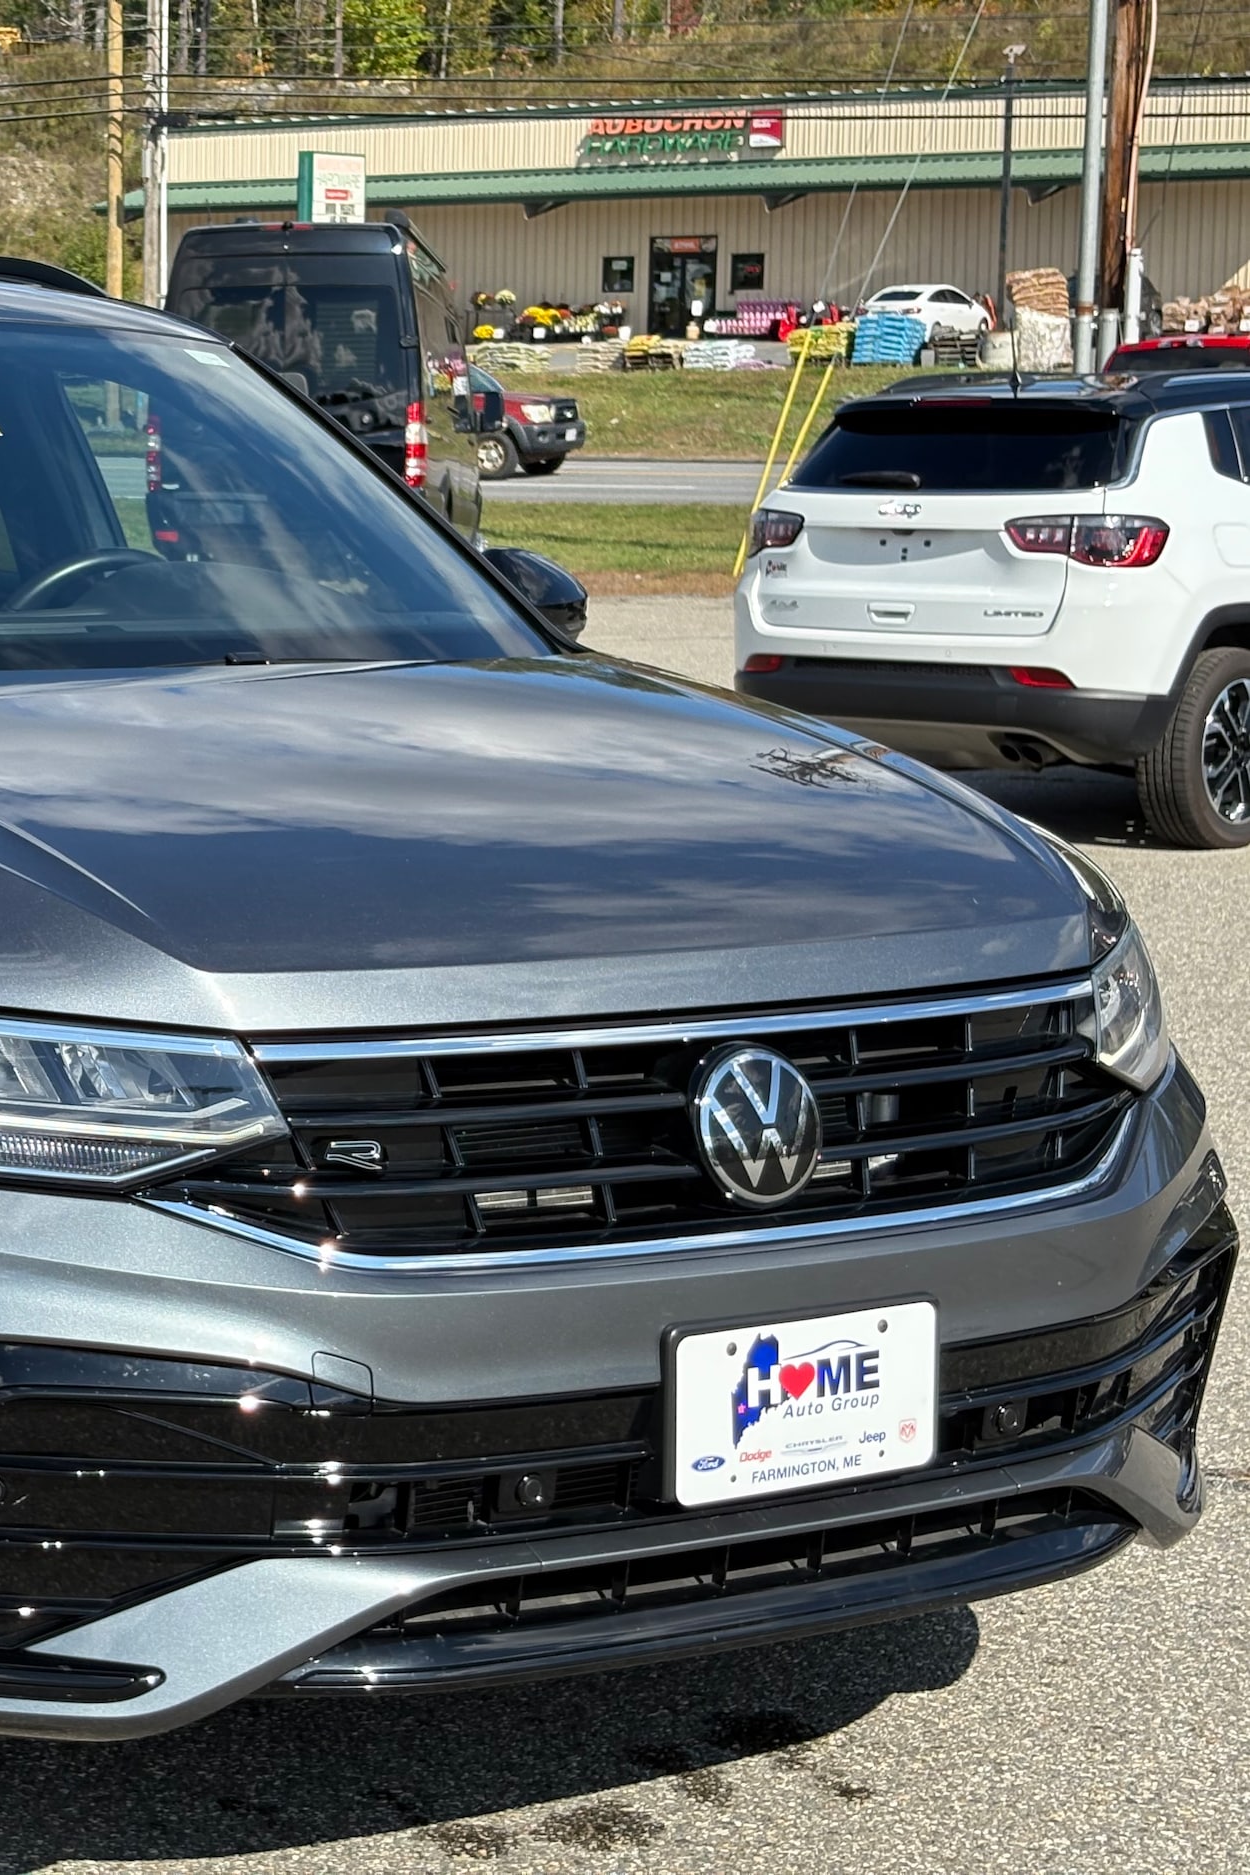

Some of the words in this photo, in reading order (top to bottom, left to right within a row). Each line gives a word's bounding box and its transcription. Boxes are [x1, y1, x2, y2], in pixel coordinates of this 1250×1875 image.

[589, 110, 747, 135] AUBUCHON
[586, 131, 744, 156] HARDWARE
[782, 1404, 824, 1419] Auto
[831, 1393, 880, 1413] Group
[859, 1431, 886, 1445] Jeep
[697, 1457, 720, 1471] Ford
[740, 1449, 772, 1463] Dodge
[751, 1459, 839, 1484] FARMINGTON,
[843, 1454, 863, 1470] ME
